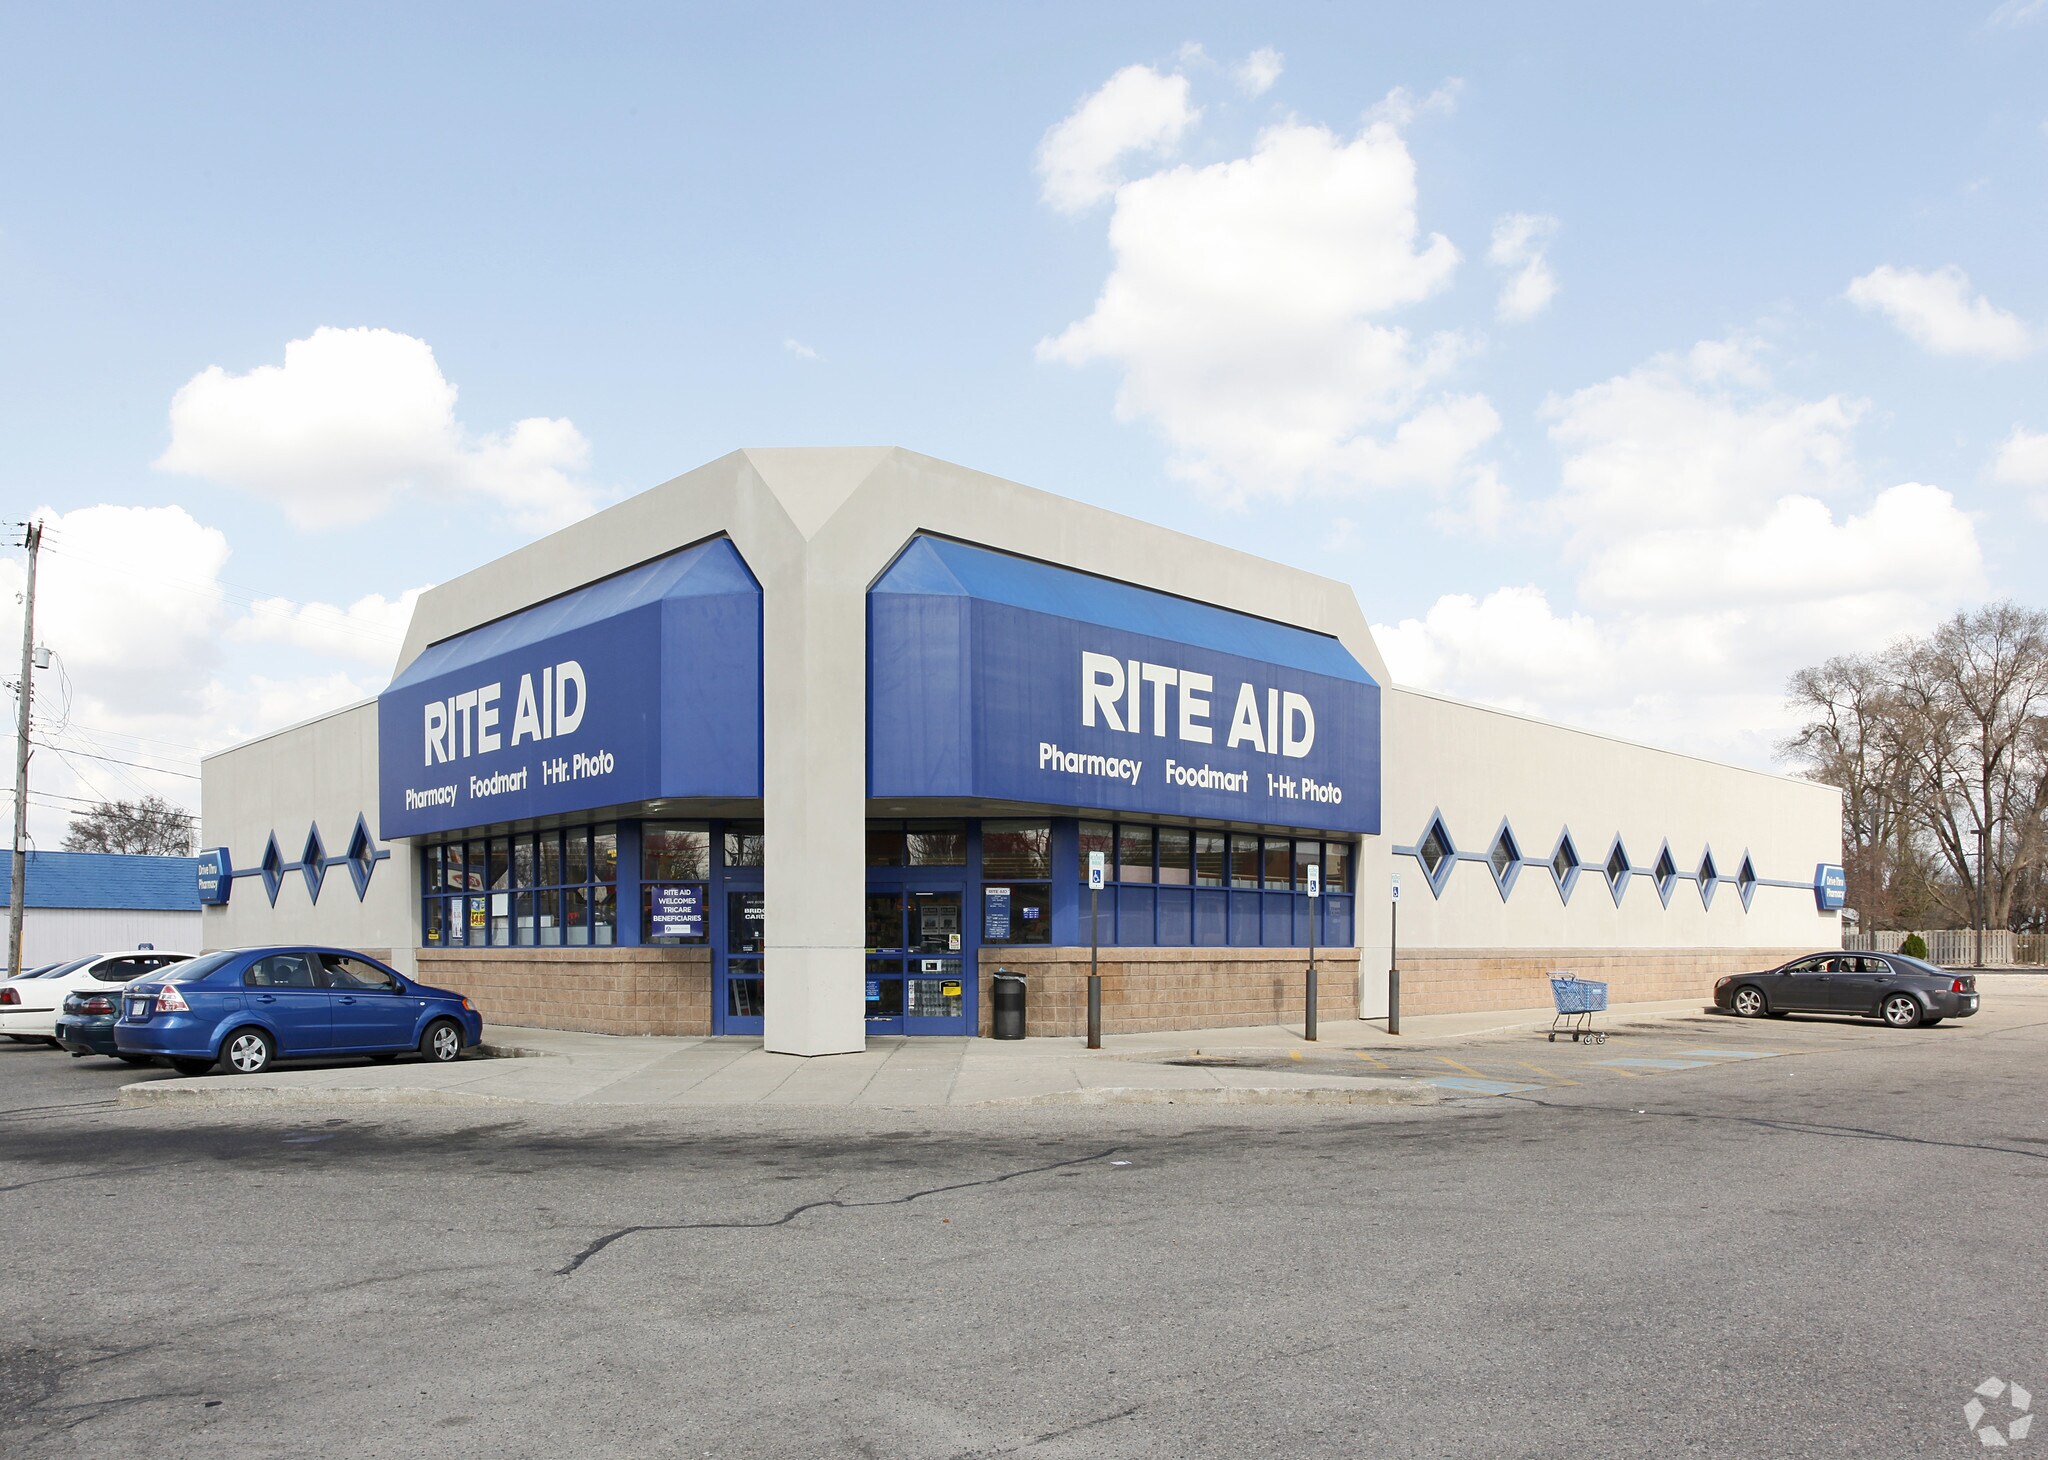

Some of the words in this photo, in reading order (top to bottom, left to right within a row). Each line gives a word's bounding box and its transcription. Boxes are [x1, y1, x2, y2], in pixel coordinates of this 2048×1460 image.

[424, 682, 501, 767] RITE
[511, 660, 587, 746] AID
[1082, 651, 1213, 744] RITE
[1227, 682, 1315, 758] AID
[405, 784, 457, 811] Pharmacy
[470, 766, 528, 800] Foodmart
[542, 757, 570, 786] 1-Hr.
[572, 749, 615, 780] Photo
[1039, 742, 1142, 786] Pharmacy
[1165, 759, 1248, 793] Foodmart
[1267, 773, 1299, 799] 1-Hr.
[1301, 778, 1342, 805] Photo
[199, 864, 209, 875] Drive
[199, 880, 217, 891] Pharmacy
